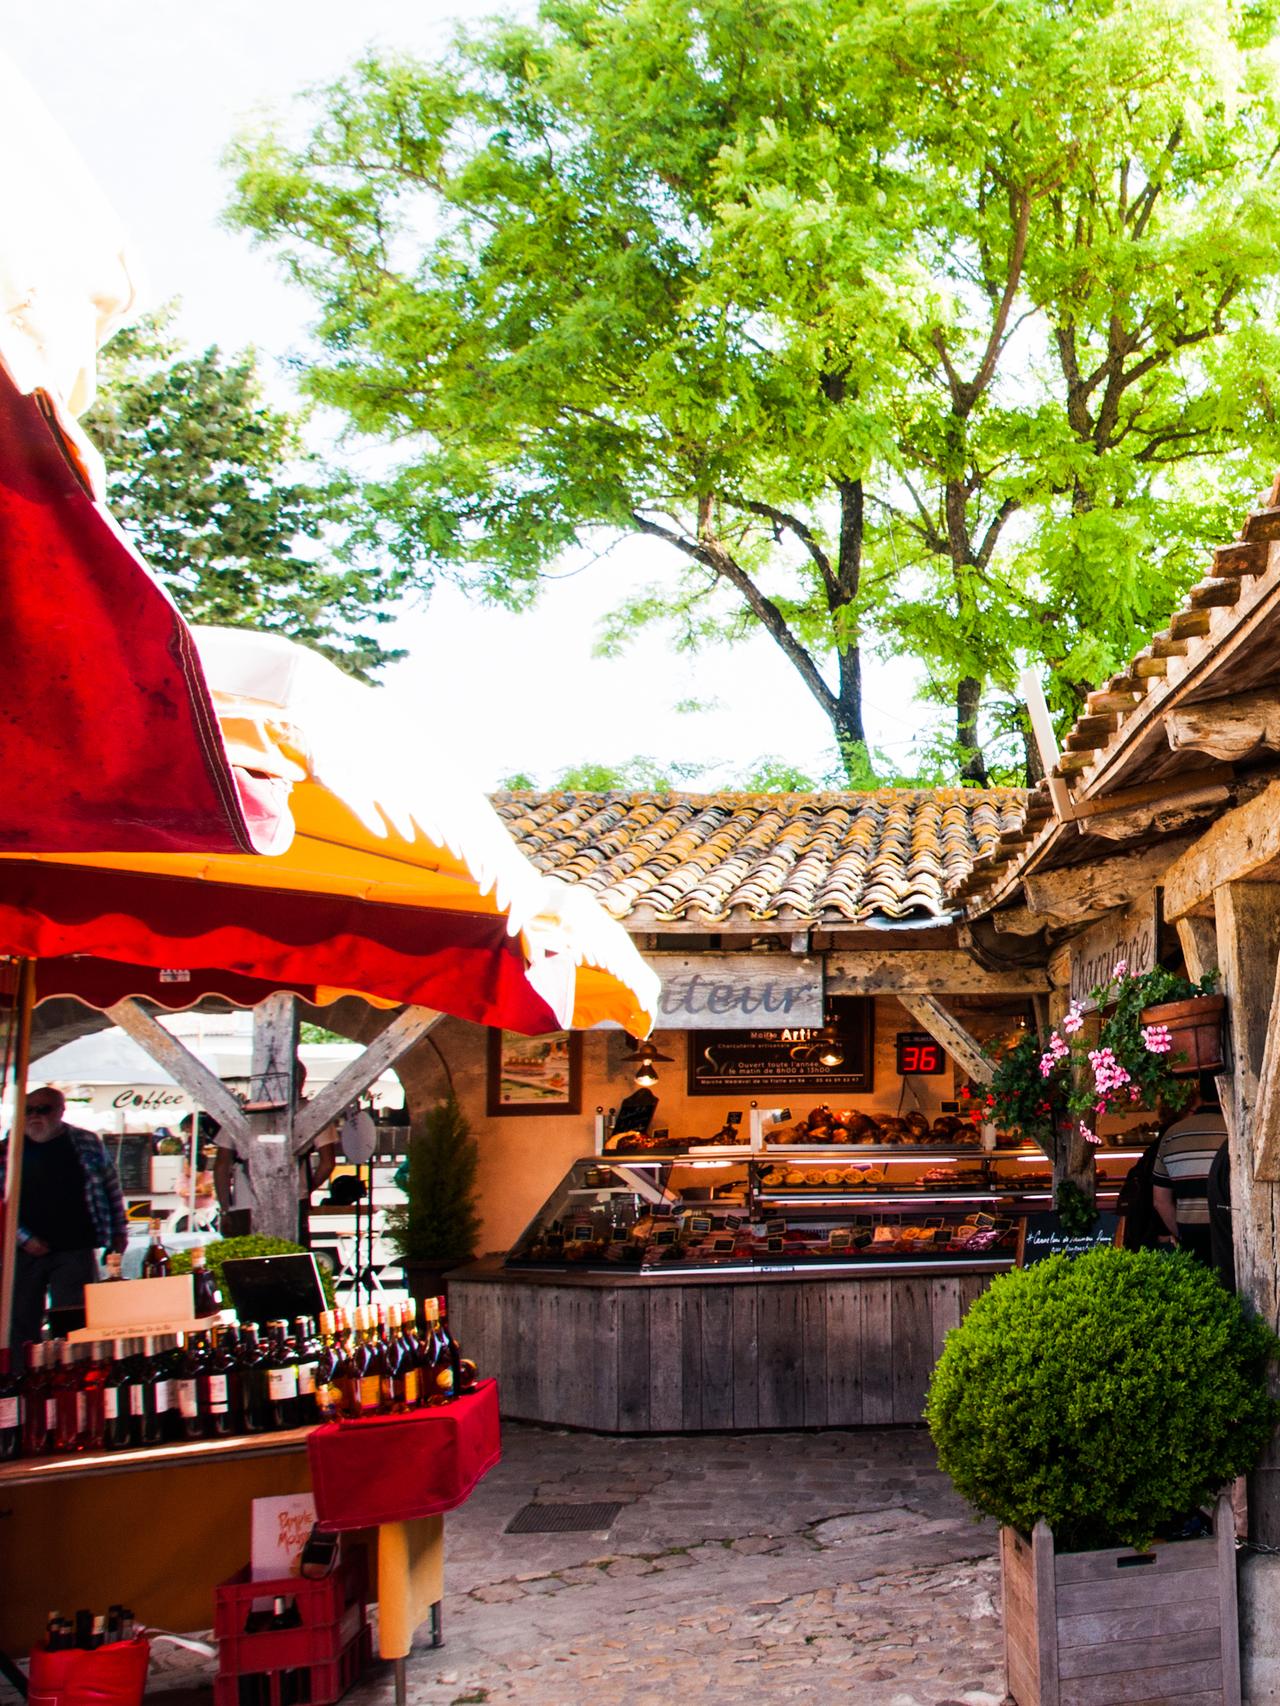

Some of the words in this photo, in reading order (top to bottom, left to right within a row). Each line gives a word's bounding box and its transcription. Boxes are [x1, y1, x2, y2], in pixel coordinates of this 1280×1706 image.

[656, 974, 815, 1014] iteur
[904, 1046, 936, 1071] 36
[112, 1089, 183, 1110] Coffee
